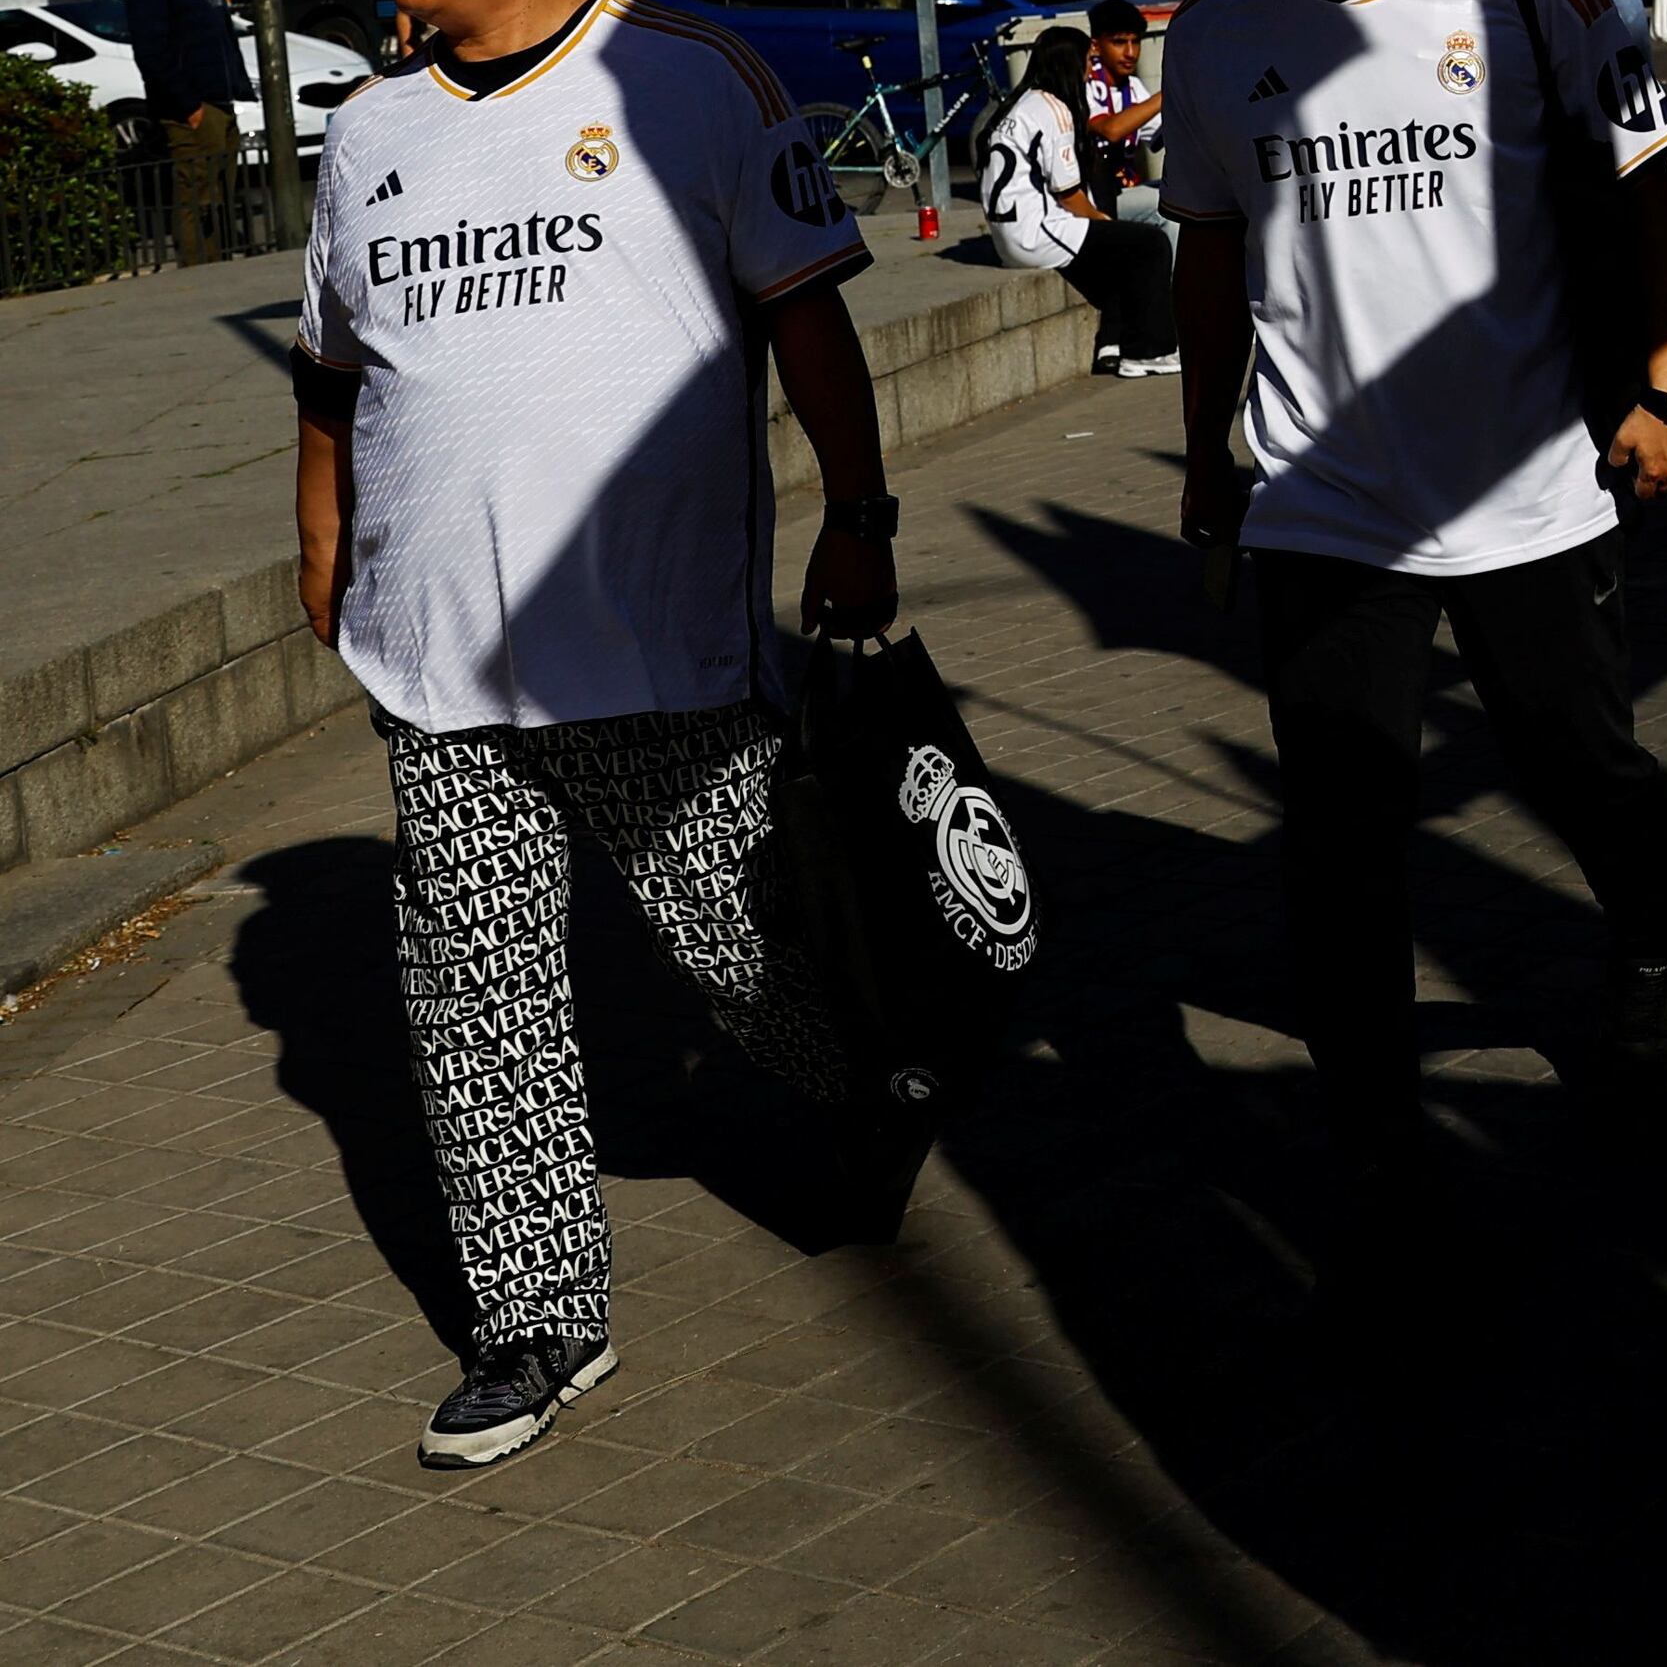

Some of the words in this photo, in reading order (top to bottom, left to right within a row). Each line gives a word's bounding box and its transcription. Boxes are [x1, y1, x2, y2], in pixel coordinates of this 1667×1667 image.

[1252, 117, 1477, 184] Emirates
[1299, 182, 1335, 223] FLY
[1347, 170, 1445, 217] BETTER
[366, 211, 603, 288] Emirates
[403, 279, 445, 327] FLY
[455, 264, 567, 315] BETTER
